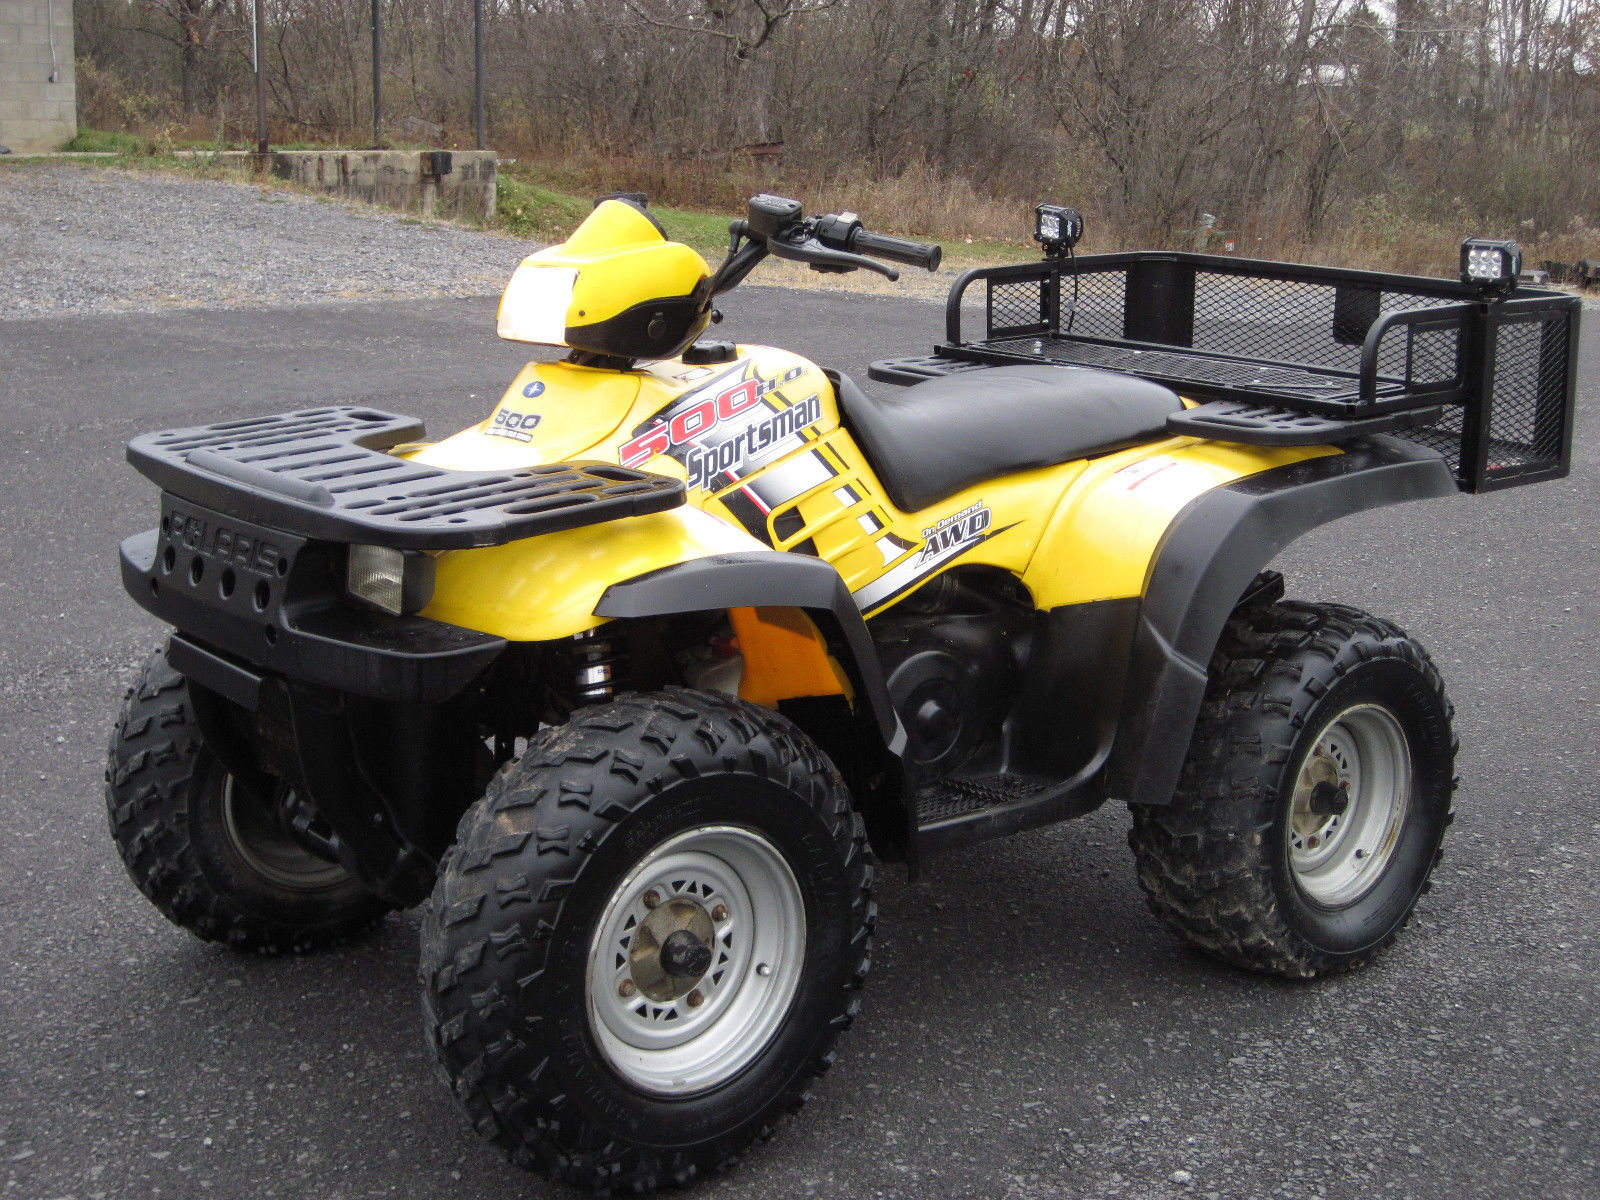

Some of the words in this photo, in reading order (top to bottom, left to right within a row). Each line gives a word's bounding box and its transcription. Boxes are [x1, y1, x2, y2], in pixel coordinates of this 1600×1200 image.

[494, 407, 542, 430] 500
[618, 377, 761, 469] 500
[686, 393, 822, 492] Sportsman
[914, 507, 992, 569] AWD
[922, 526, 936, 538] On
[937, 499, 983, 528] Demand
